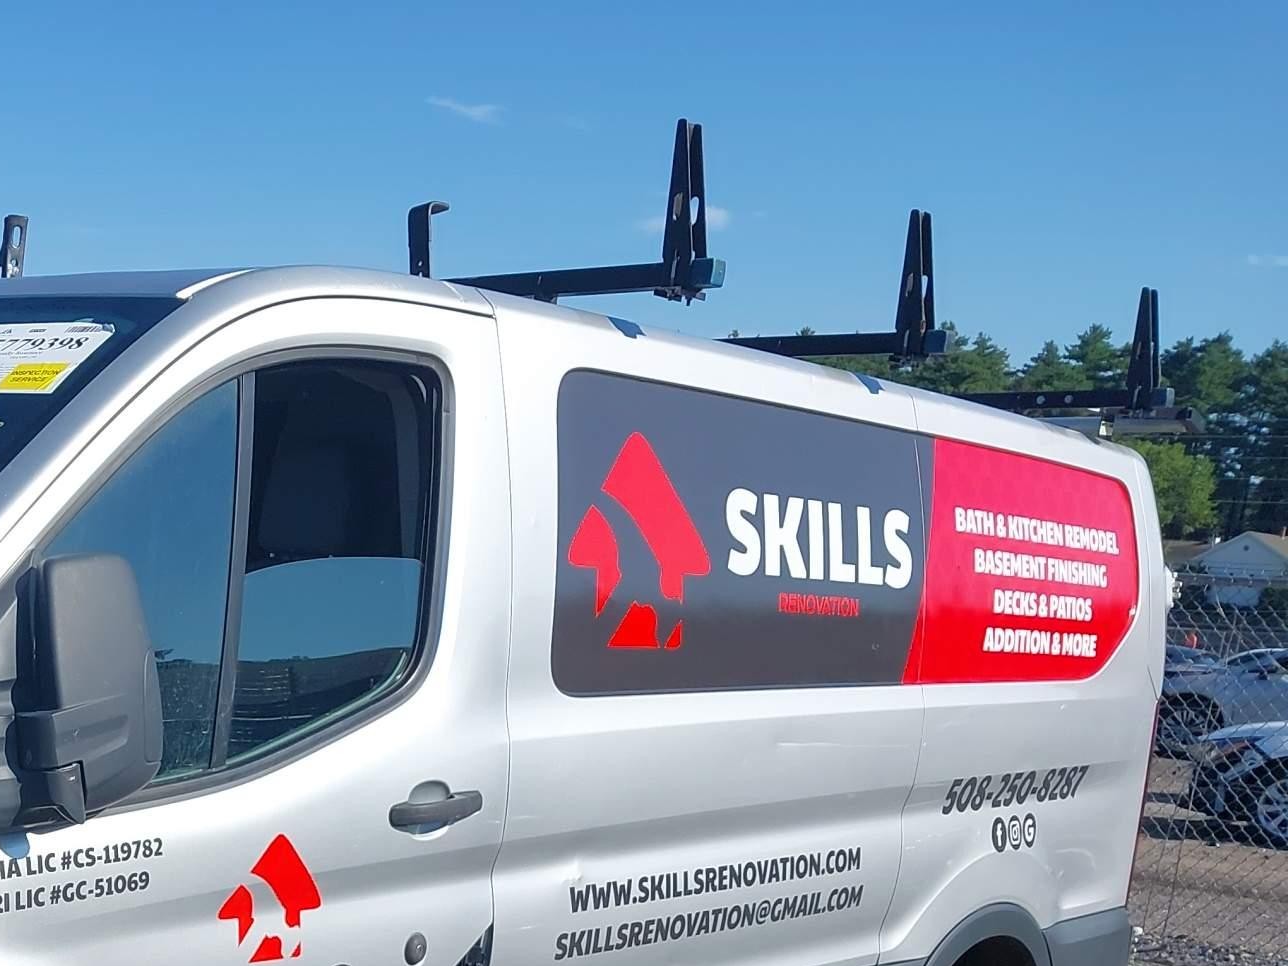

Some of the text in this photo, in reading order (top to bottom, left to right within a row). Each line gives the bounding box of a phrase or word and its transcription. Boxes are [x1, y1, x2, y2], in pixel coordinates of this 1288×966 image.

[726, 487, 912, 590] SKILLS
[954, 506, 1120, 555] BATH & KITCHEN REMODEL
[974, 548, 1108, 588] BASEMENT FINISHING
[776, 592, 861, 617] RENOVATION
[993, 589, 1093, 622] DECKS & PATIOS
[982, 627, 1098, 658] ADDITION & MORE
[941, 764, 1091, 815] 508-250-8287
[26, 852, 57, 876] LIC
[61, 837, 164, 871] #CS-119782
[15, 886, 46, 912] LIC
[49, 871, 151, 905] #GC-51069
[569, 847, 862, 914] WWW.SKILLSRENOVATION.COM
[554, 884, 864, 961] SKILLSRENOVATION@GMAIL.COM
